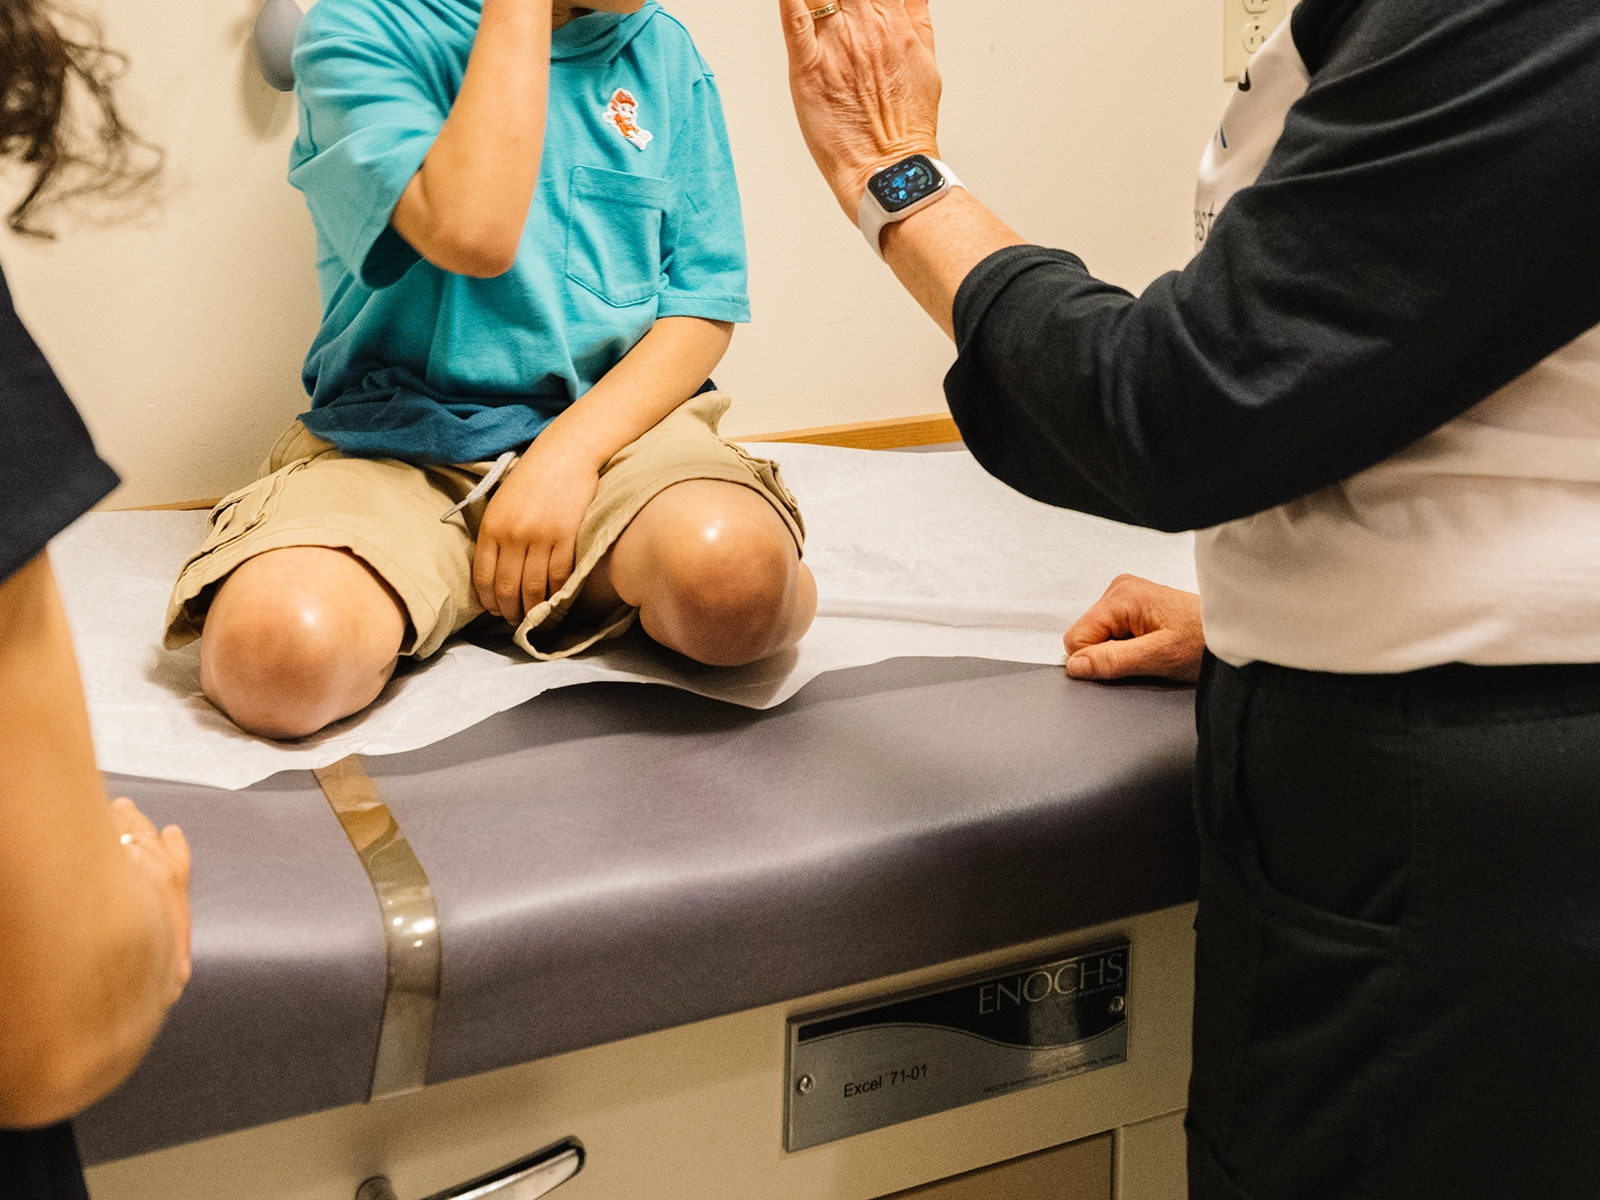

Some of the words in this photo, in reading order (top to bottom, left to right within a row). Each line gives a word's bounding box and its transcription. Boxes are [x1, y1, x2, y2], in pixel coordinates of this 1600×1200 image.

[979, 953, 1123, 1015] ENOCHS
[843, 1076, 883, 1099] Excel
[890, 1064, 928, 1087] 71-01
